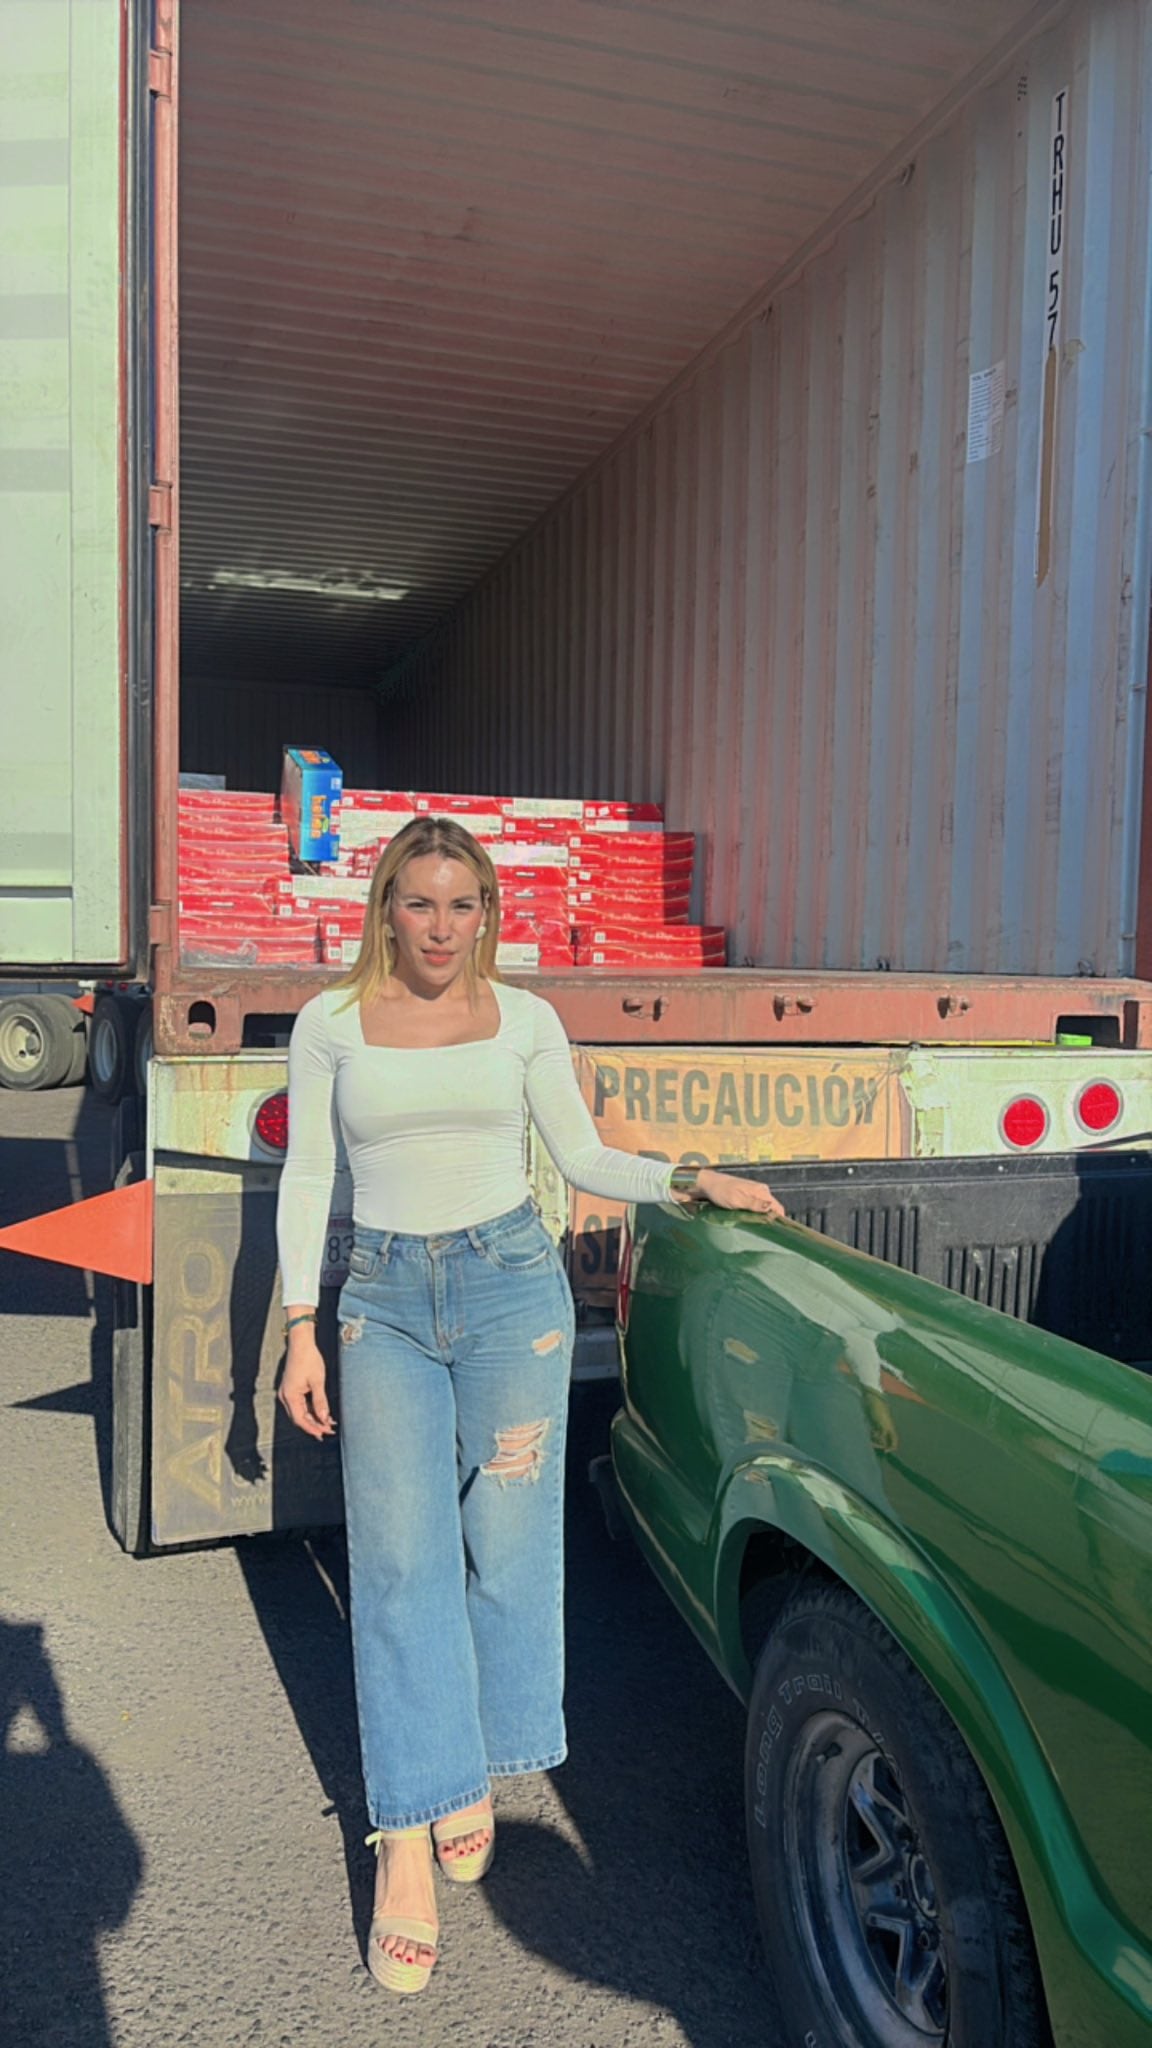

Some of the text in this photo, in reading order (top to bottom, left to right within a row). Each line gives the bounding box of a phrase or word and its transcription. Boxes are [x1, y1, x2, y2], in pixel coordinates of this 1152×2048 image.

[1050, 91, 1066, 255] TRHU
[593, 1063, 877, 1127] PRECAUCIÓN
[166, 1239, 224, 1510] ATRO
[777, 1674, 843, 1705] Trail
